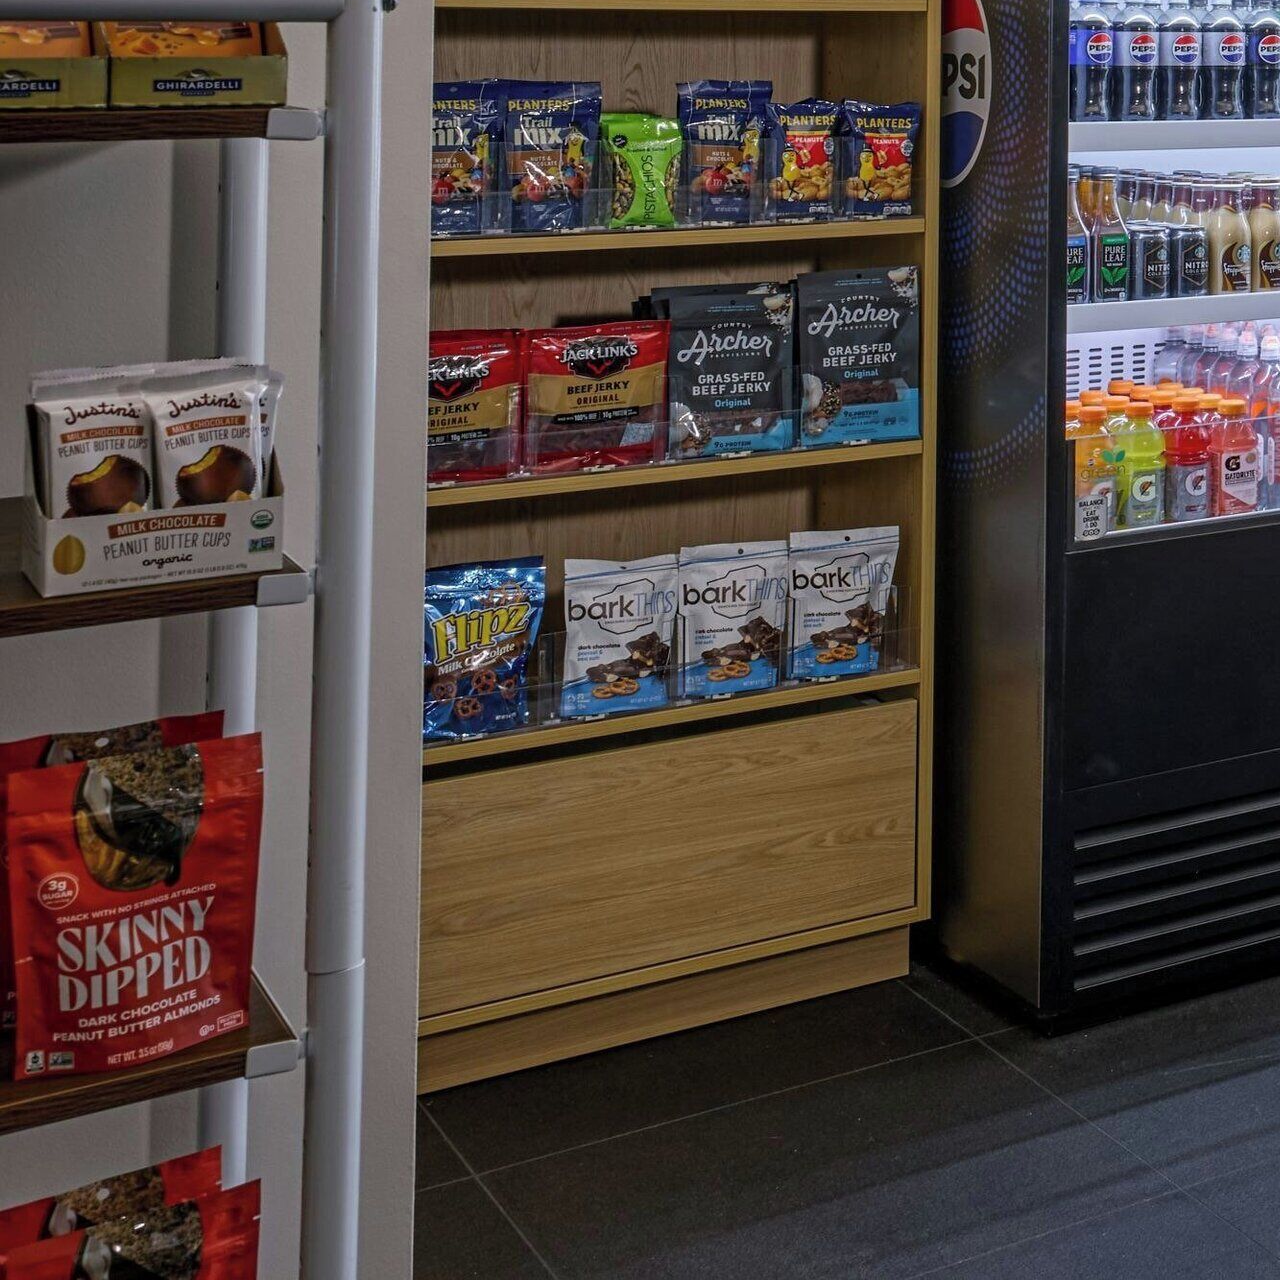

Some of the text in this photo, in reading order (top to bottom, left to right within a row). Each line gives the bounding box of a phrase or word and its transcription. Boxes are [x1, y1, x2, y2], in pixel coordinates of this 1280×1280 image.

[508, 100, 570, 111] PLANTERS
[695, 99, 747, 110] PLANTERS
[522, 117, 552, 128] Trail
[780, 115, 836, 126] PLANTERS
[857, 118, 912, 128] PLANTERS
[514, 127, 563, 145] mix
[699, 123, 743, 141] mix
[643, 154, 654, 220] PISTACHIOS
[1105, 246, 1125, 254] PURE
[841, 295, 880, 304] COUNTRY
[807, 303, 900, 338] Archer
[560, 344, 638, 363] JACK LINK'S
[677, 329, 772, 366] Archer
[828, 342, 892, 356] GRASS-FED
[822, 352, 897, 367] BEEF JERKY
[698, 371, 765, 384] GRASS-FED
[844, 369, 879, 379] Original
[567, 380, 630, 395] BEEF JERKY
[692, 381, 771, 396] BEEF JERKY
[576, 394, 618, 405] ORIGINAL
[714, 398, 751, 408] Original
[64, 402, 141, 425] Justin's
[165, 430, 229, 450] PEANUT BUTTER
[58, 438, 148, 458] PEANUT BUTTER CUPS
[1079, 499, 1104, 508] BALANCE
[117, 515, 216, 536] MILK CHOCOLATE
[103, 538, 150, 560] PEANUT
[154, 535, 199, 551] BUTTER
[203, 532, 231, 547] CUPS
[142, 553, 193, 569] organic
[438, 660, 462, 675] Milk
[48, 880, 68, 892] 3g
[56, 882, 217, 925] SNACK WITH NO STRINGS ATTACHED
[57, 895, 216, 972] SKINNY
[59, 936, 212, 1012] DIPPED
[78, 989, 197, 1028] DARK CHOCOLATE
[53, 995, 221, 1042] PEANUT BUTTER ALMONDS
